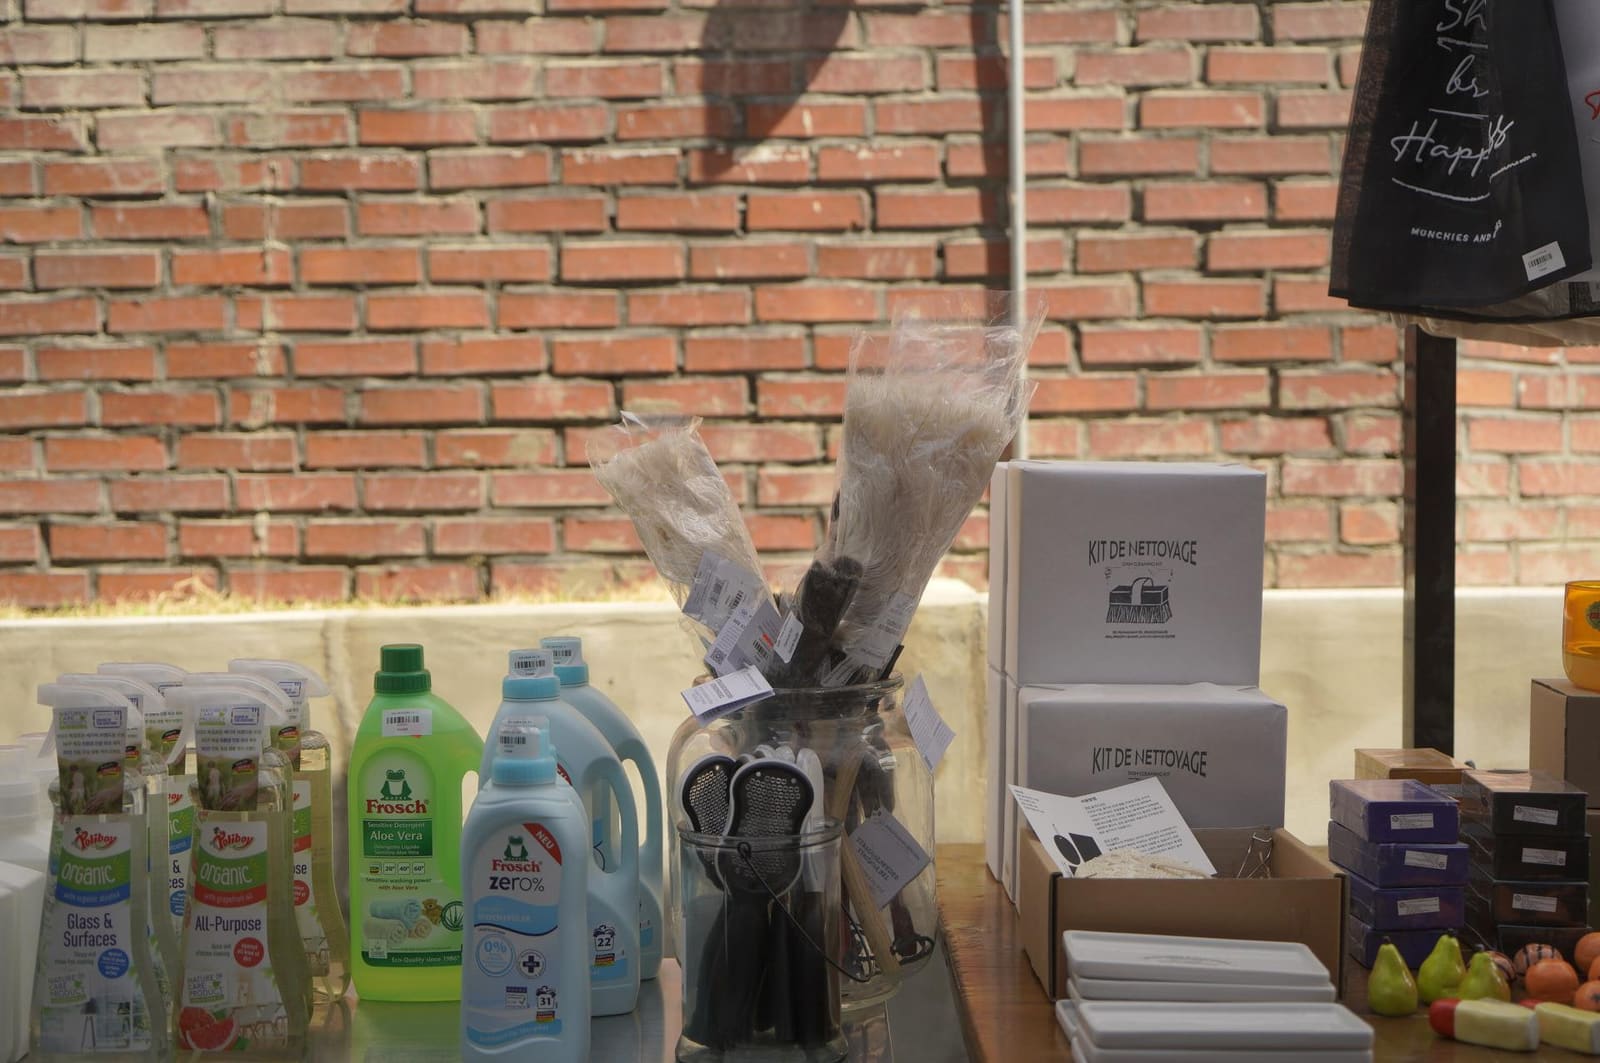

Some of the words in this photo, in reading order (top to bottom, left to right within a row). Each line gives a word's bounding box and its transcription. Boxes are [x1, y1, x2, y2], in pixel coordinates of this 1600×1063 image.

[1410, 227, 1470, 242] MUNCHIES
[1088, 540, 1107, 567] KIT
[1109, 541, 1126, 559] DE
[1129, 540, 1198, 566] NETTOYAGE
[1092, 747, 1112, 775] KIT
[1114, 748, 1132, 768] DE
[1134, 749, 1208, 777] NETTOYAGE
[366, 799, 428, 814] Frosch
[74, 830, 118, 851] Poliboy
[212, 829, 254, 851] Poliboy
[370, 831, 394, 841] Aloe
[397, 831, 423, 841] Vera
[535, 831, 555, 850] NEU
[491, 859, 541, 872] Frosch
[60, 863, 116, 886] organic
[200, 862, 253, 886] organic
[489, 876, 545, 892] zero%
[67, 913, 100, 929] Glass
[104, 913, 113, 929] &
[195, 915, 262, 935] All-Purpose
[63, 931, 117, 947] Surfaces
[597, 937, 612, 947] 22
[539, 997, 551, 1006] 31
